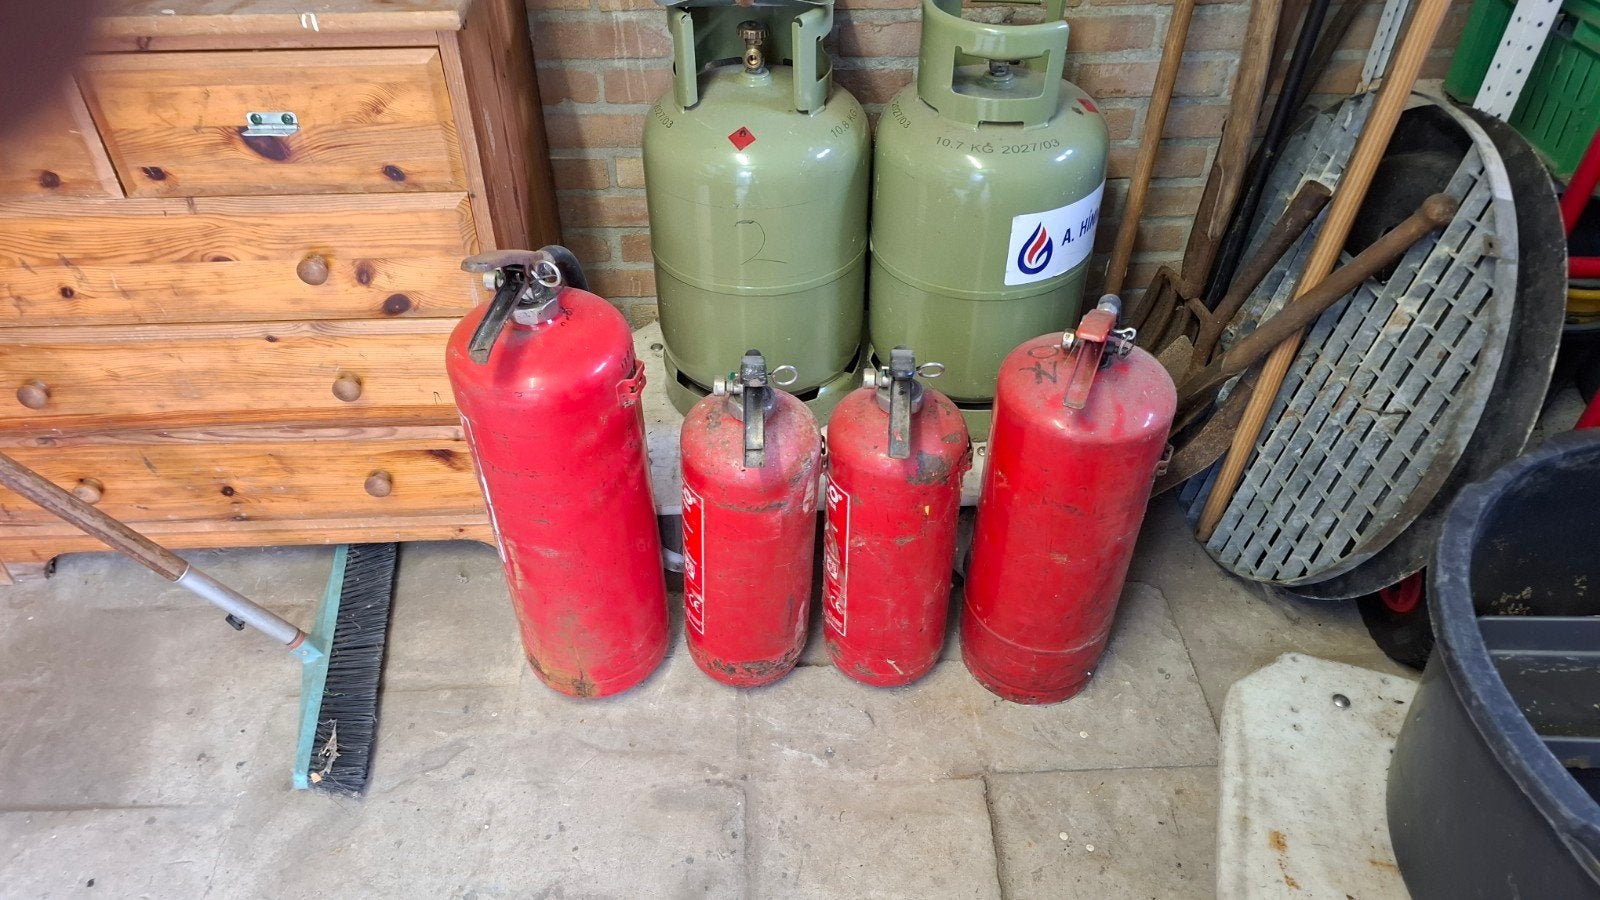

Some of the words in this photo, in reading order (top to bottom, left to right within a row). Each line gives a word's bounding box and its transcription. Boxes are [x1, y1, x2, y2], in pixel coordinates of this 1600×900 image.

[830, 120, 849, 138] 10.8
[847, 108, 857, 122] KG
[936, 136, 964, 150] 10.7
[970, 142, 994, 154] KG
[1001, 138, 1060, 155] 2027/03
[734, 219, 788, 265] 2
[1061, 228, 1075, 246] A.
